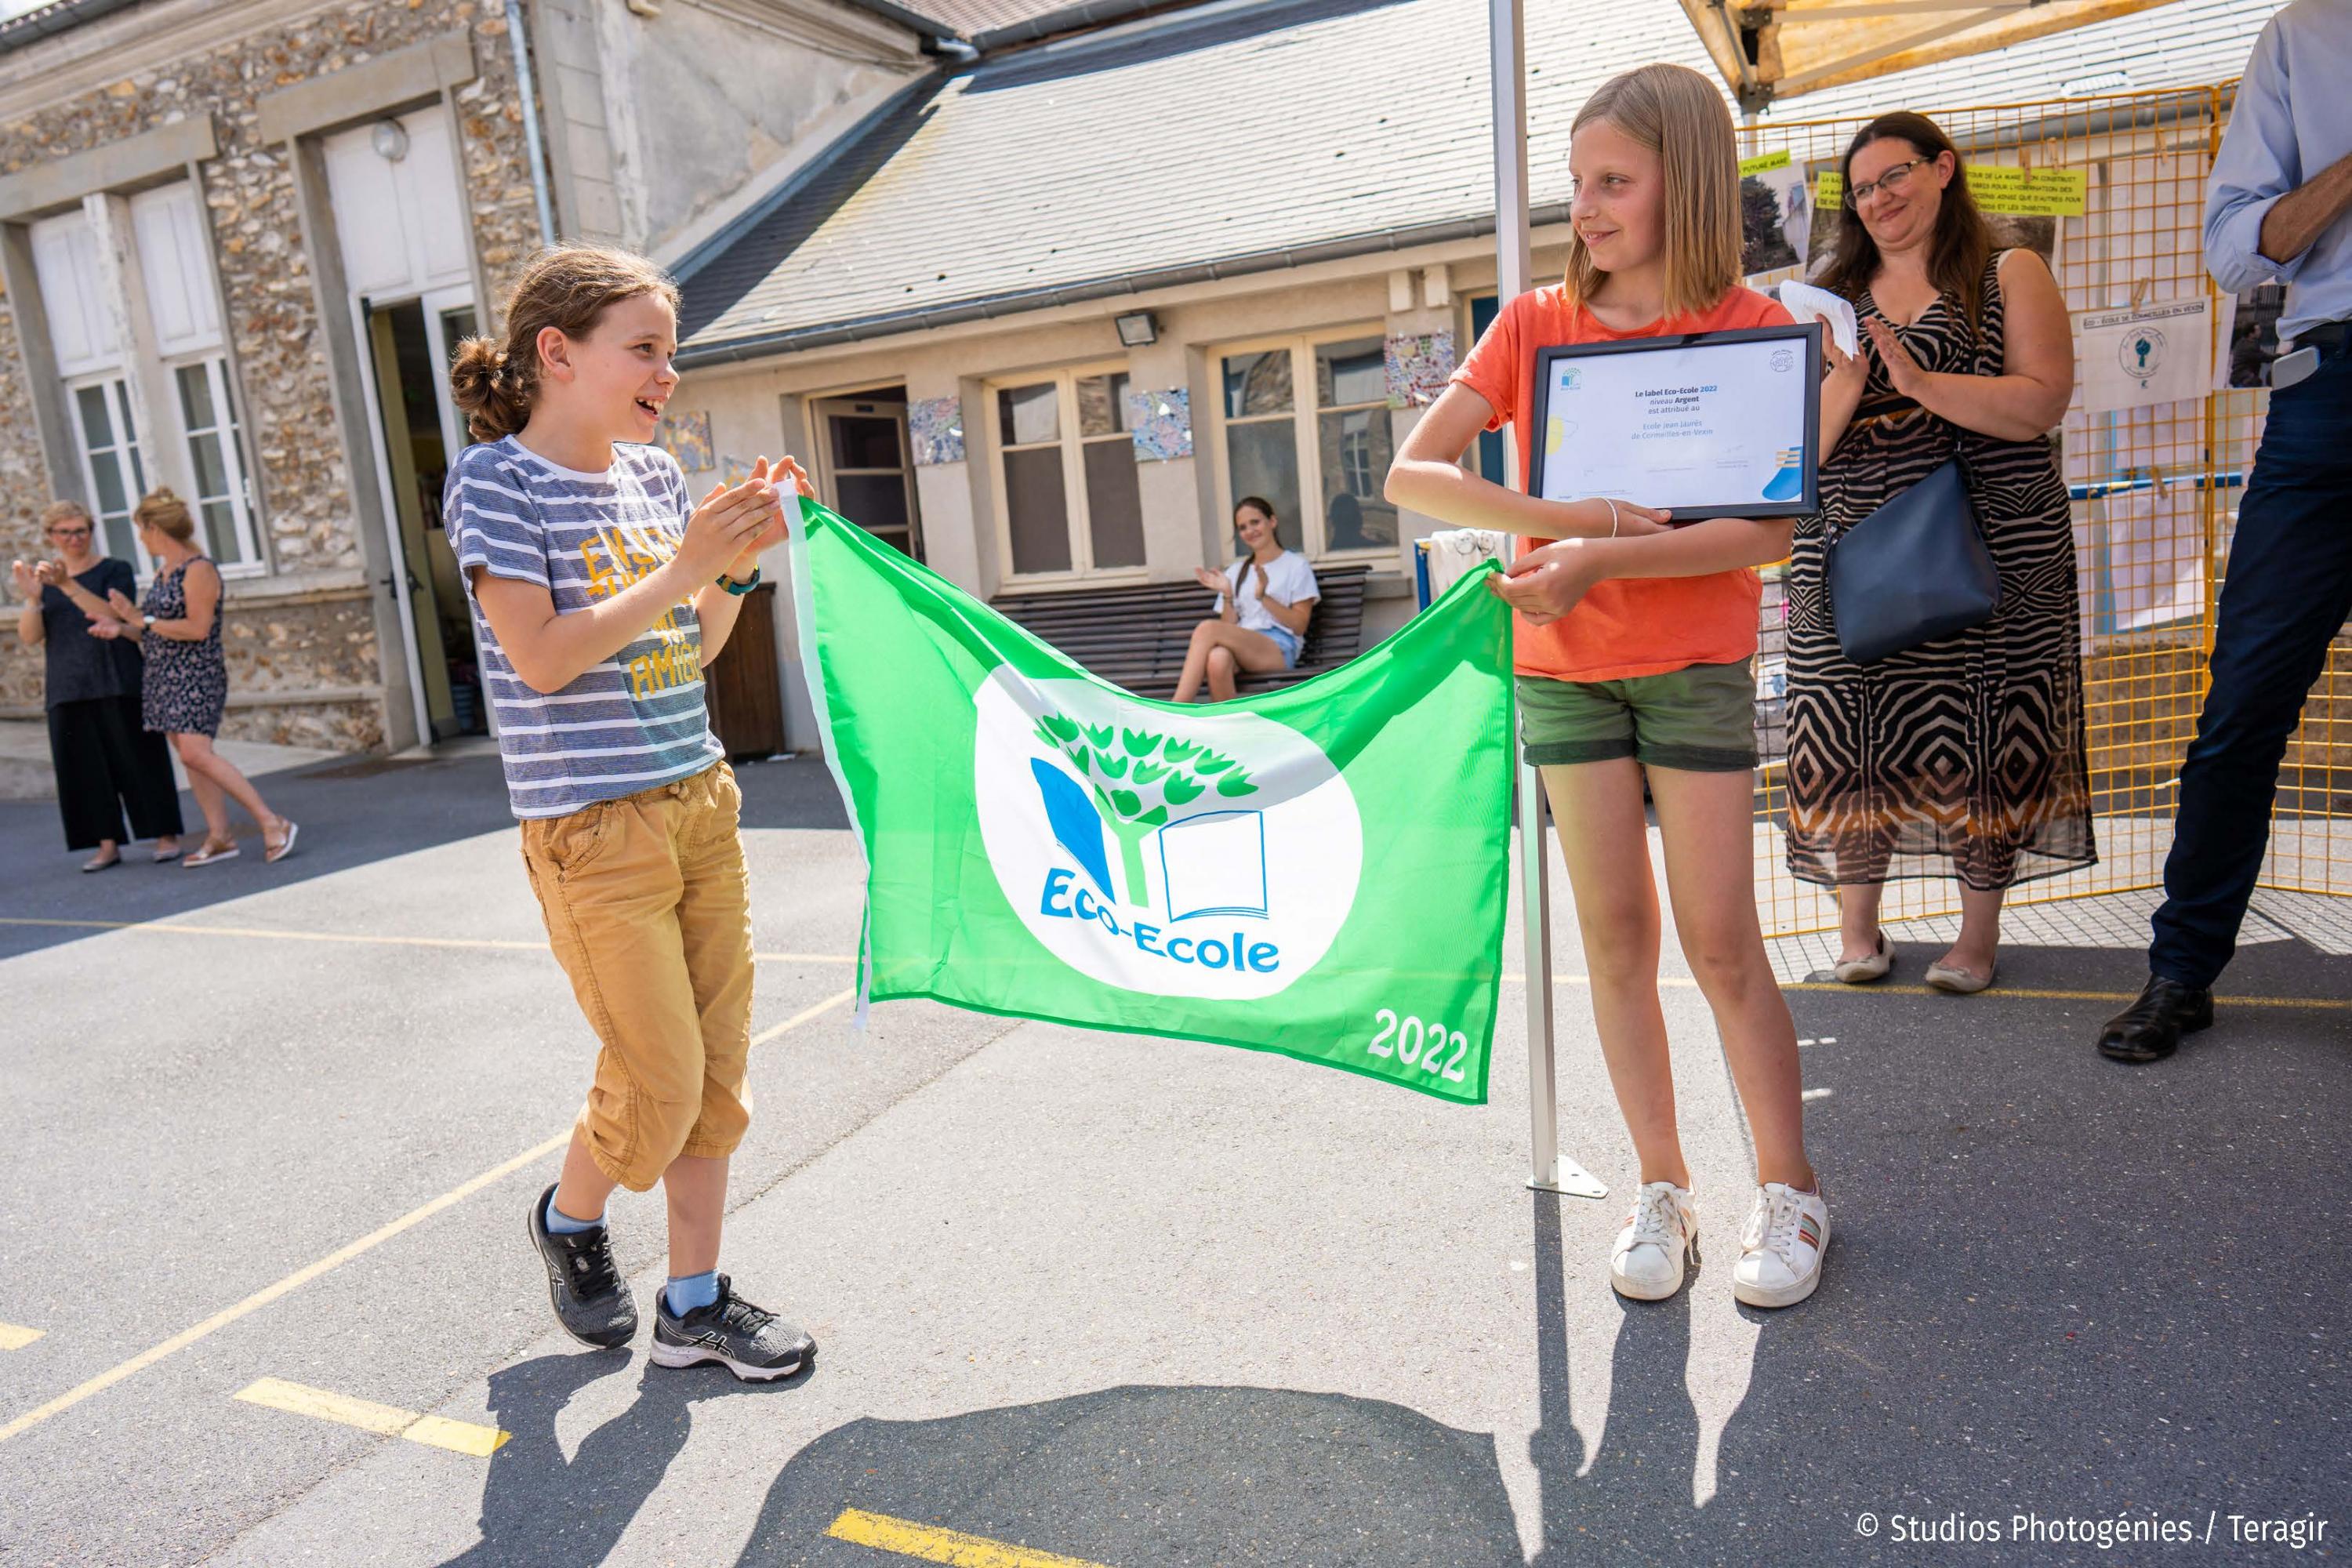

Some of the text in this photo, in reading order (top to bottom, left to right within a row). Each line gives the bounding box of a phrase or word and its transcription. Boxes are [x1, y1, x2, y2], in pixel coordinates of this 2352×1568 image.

[1664, 387, 1699, 395] Eco-Ecole
[1675, 396, 1699, 405] Argent
[1661, 405, 1690, 414] attribué
[1040, 867, 1279, 973] Eco-Ecole
[1367, 1008, 1468, 1083] 2022
